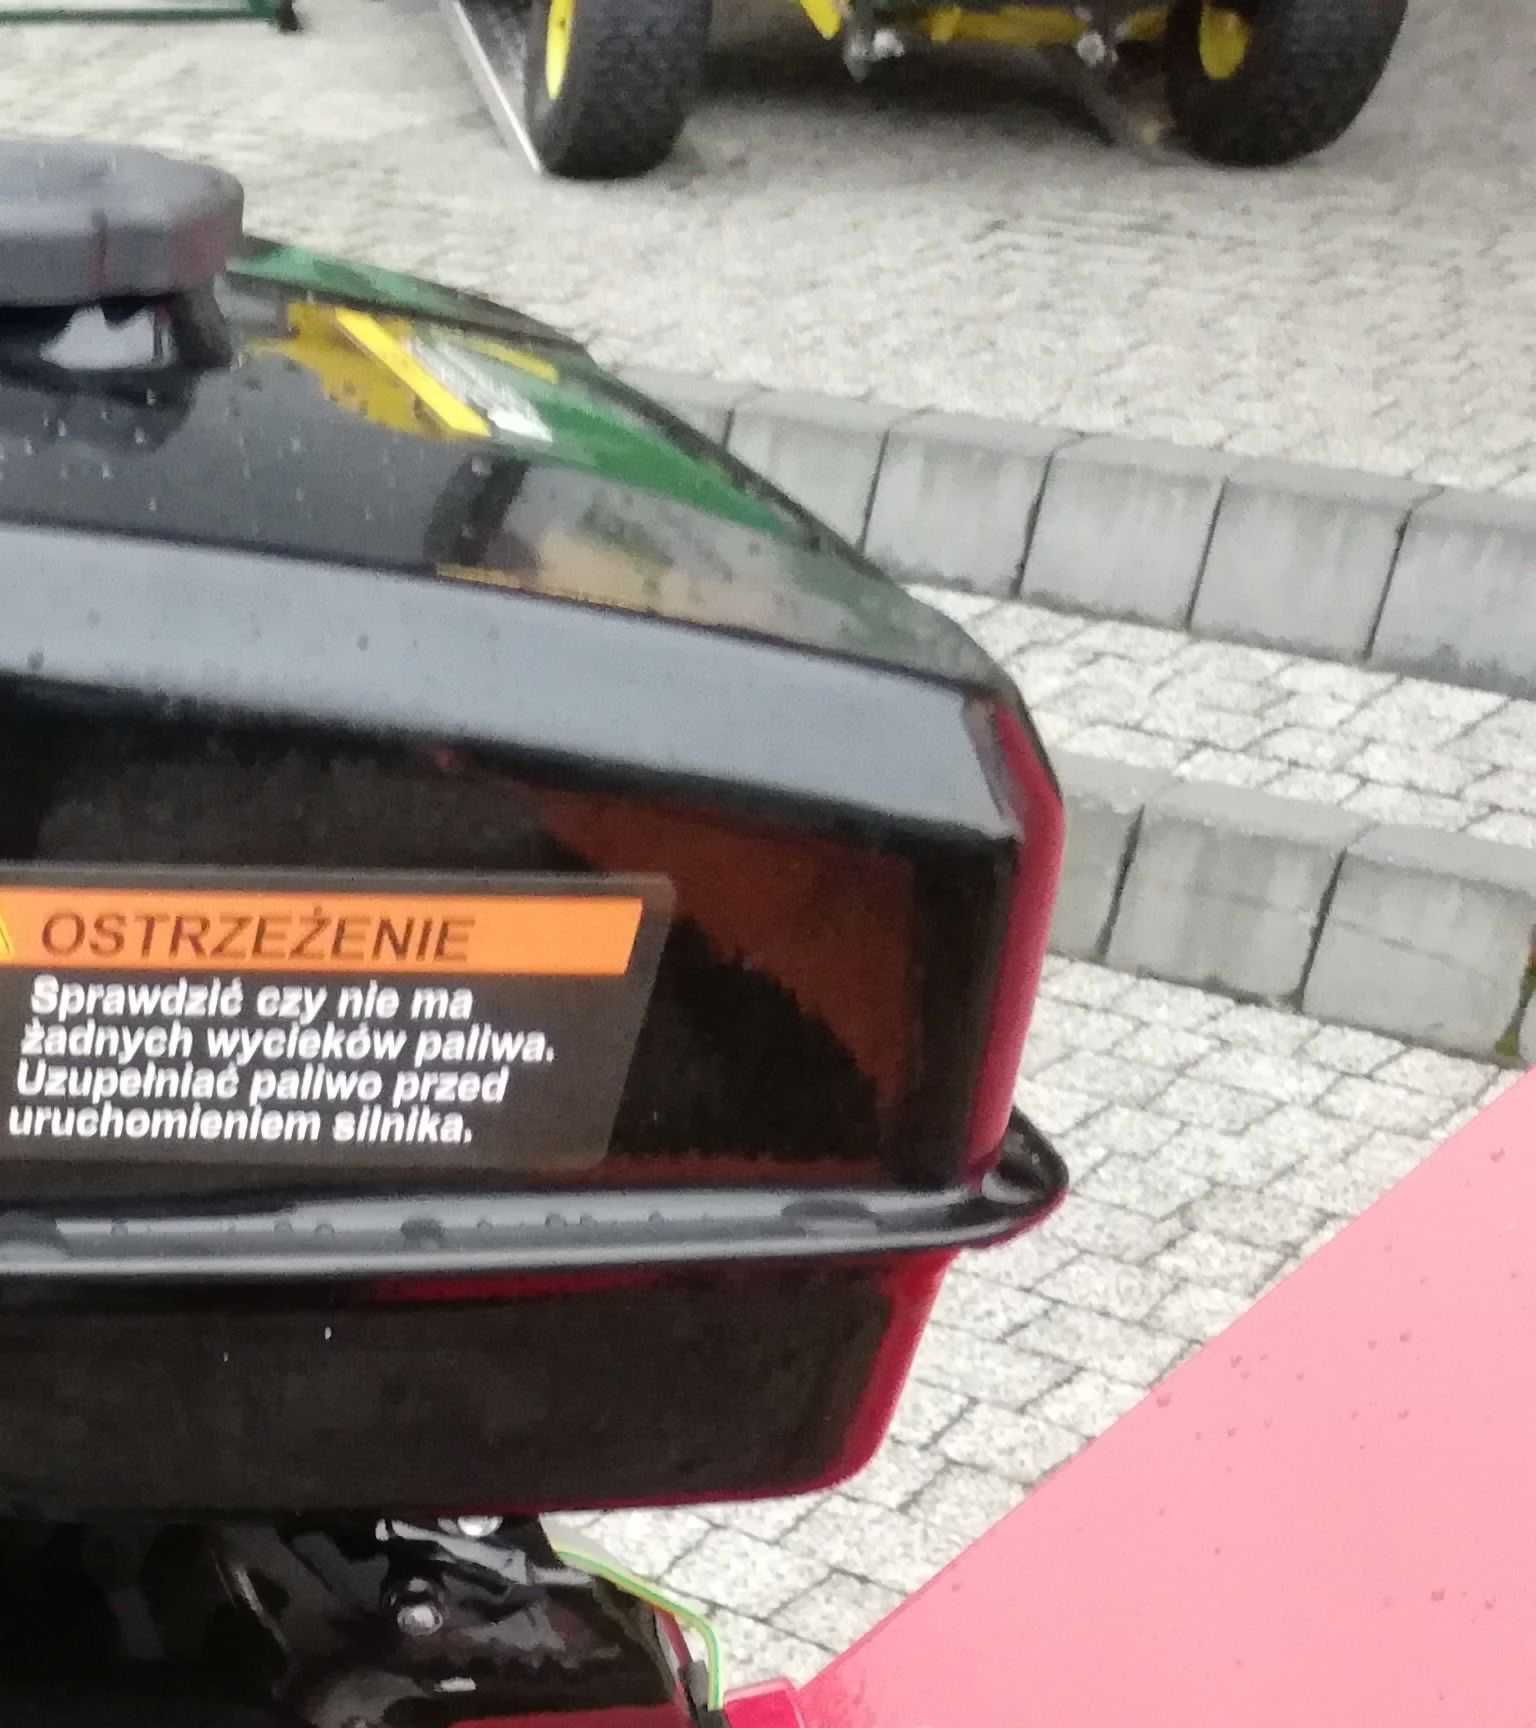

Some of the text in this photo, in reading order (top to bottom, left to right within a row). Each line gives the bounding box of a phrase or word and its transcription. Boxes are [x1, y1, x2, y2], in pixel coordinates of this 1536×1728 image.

[40, 904, 477, 963] OSTRZEŻENIE
[30, 973, 474, 1026] Sprawdzić czy nie ma
[20, 1016, 556, 1069] żadnych wycieków paliwa.
[16, 1057, 511, 1109] Uzupełniać paliwo przed
[7, 1099, 322, 1142] uruchomieniem
